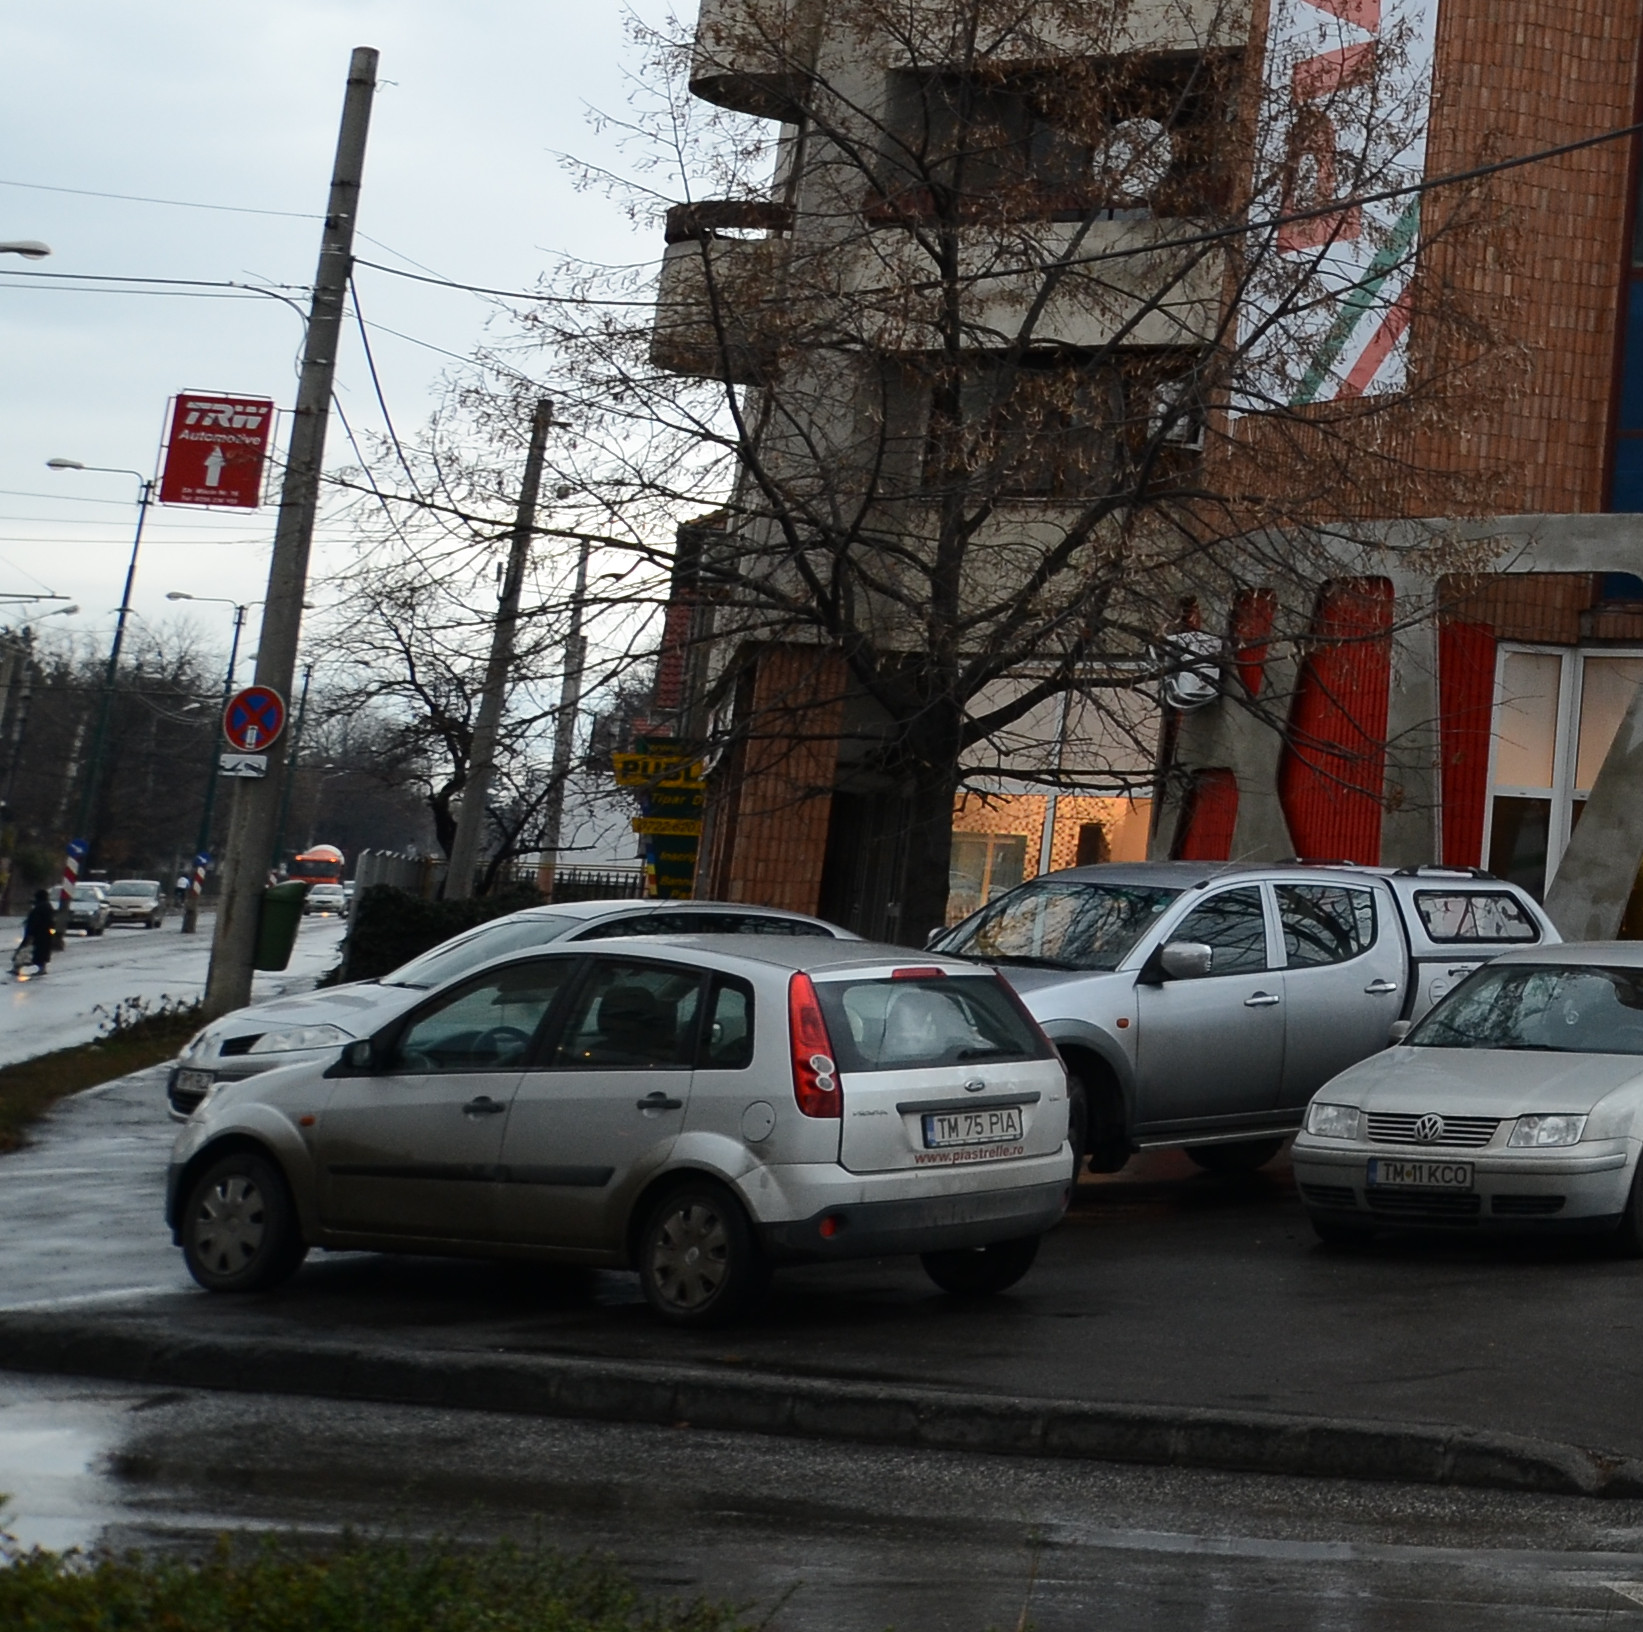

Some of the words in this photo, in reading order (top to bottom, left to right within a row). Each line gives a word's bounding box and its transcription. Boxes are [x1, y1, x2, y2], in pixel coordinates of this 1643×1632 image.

[185, 401, 269, 429] TRW
[178, 429, 262, 445] Automotive
[937, 1118, 960, 1140] TM
[964, 1115, 984, 1136] 75
[989, 1112, 1017, 1134] PIA
[914, 1145, 1024, 1164] www.piastrelle.ro
[1384, 1163, 1405, 1182] TM
[1411, 1164, 1423, 1183] 11
[1427, 1165, 1467, 1184] KCO
